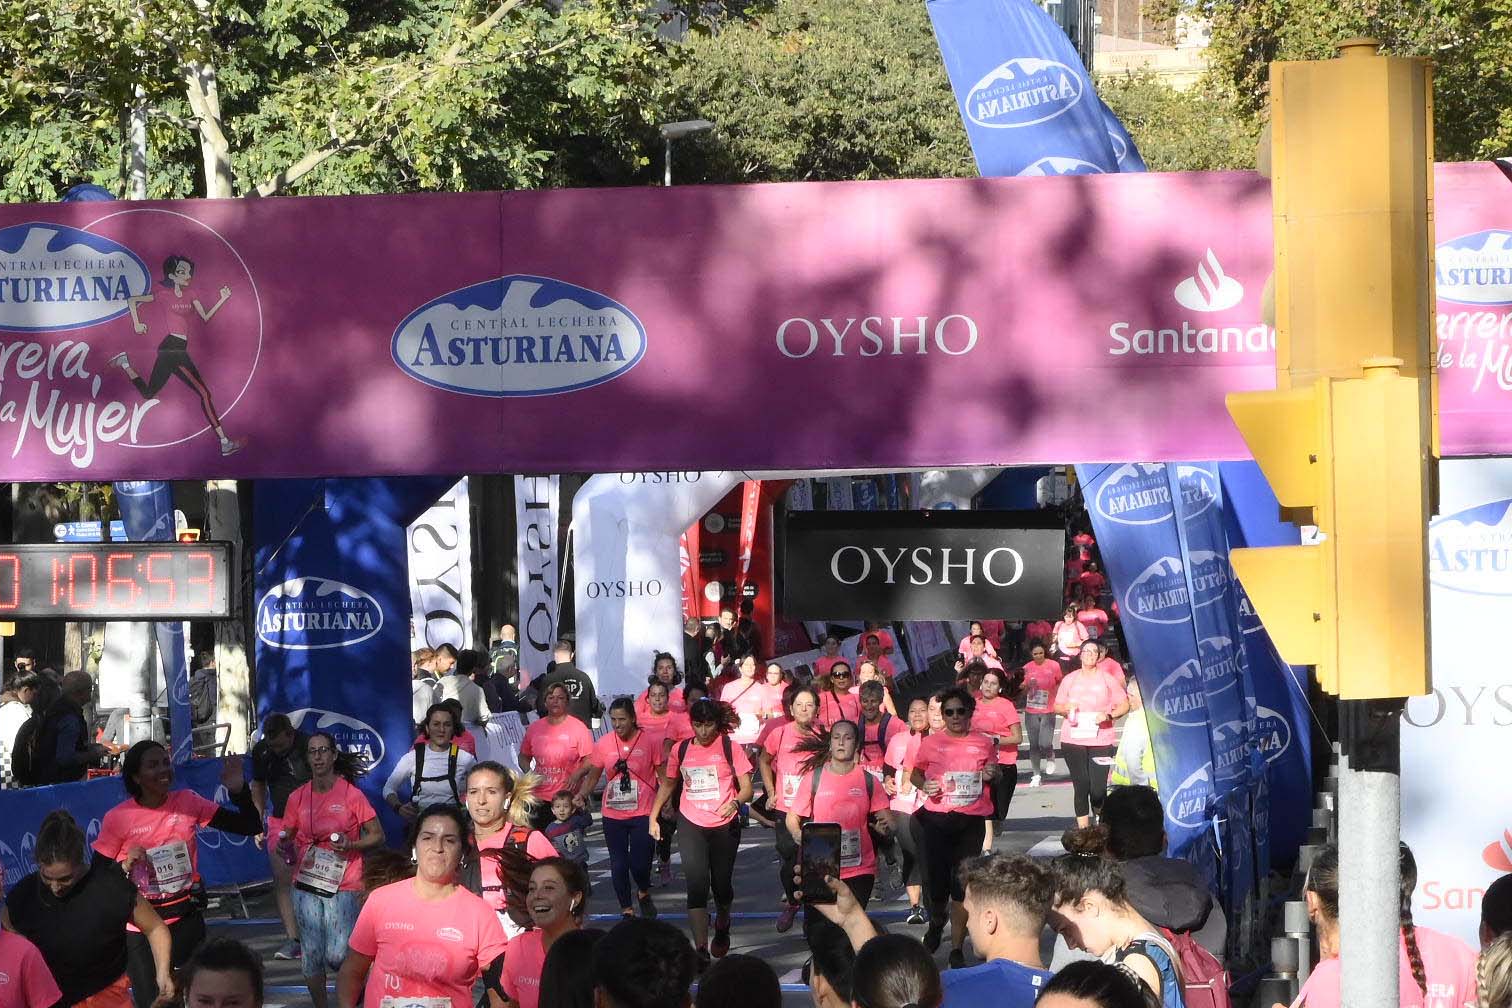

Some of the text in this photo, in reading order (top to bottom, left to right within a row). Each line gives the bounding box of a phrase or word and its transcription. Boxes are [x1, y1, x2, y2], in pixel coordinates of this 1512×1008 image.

[53, 258, 126, 271] LECHERA
[450, 315, 619, 332] CENTRAL LECHERA
[775, 314, 979, 358] OYSHO
[1108, 321, 1276, 355] Santand
[411, 322, 627, 367] ASTURIANA
[12, 375, 160, 469] Mujer
[829, 544, 1025, 587] OYSHO
[586, 579, 663, 599] OYSHO
[258, 609, 374, 634] ASTURIANA
[1402, 686, 1512, 728] OYS
[156, 863, 174, 874] 016
[384, 973, 400, 990] TU
